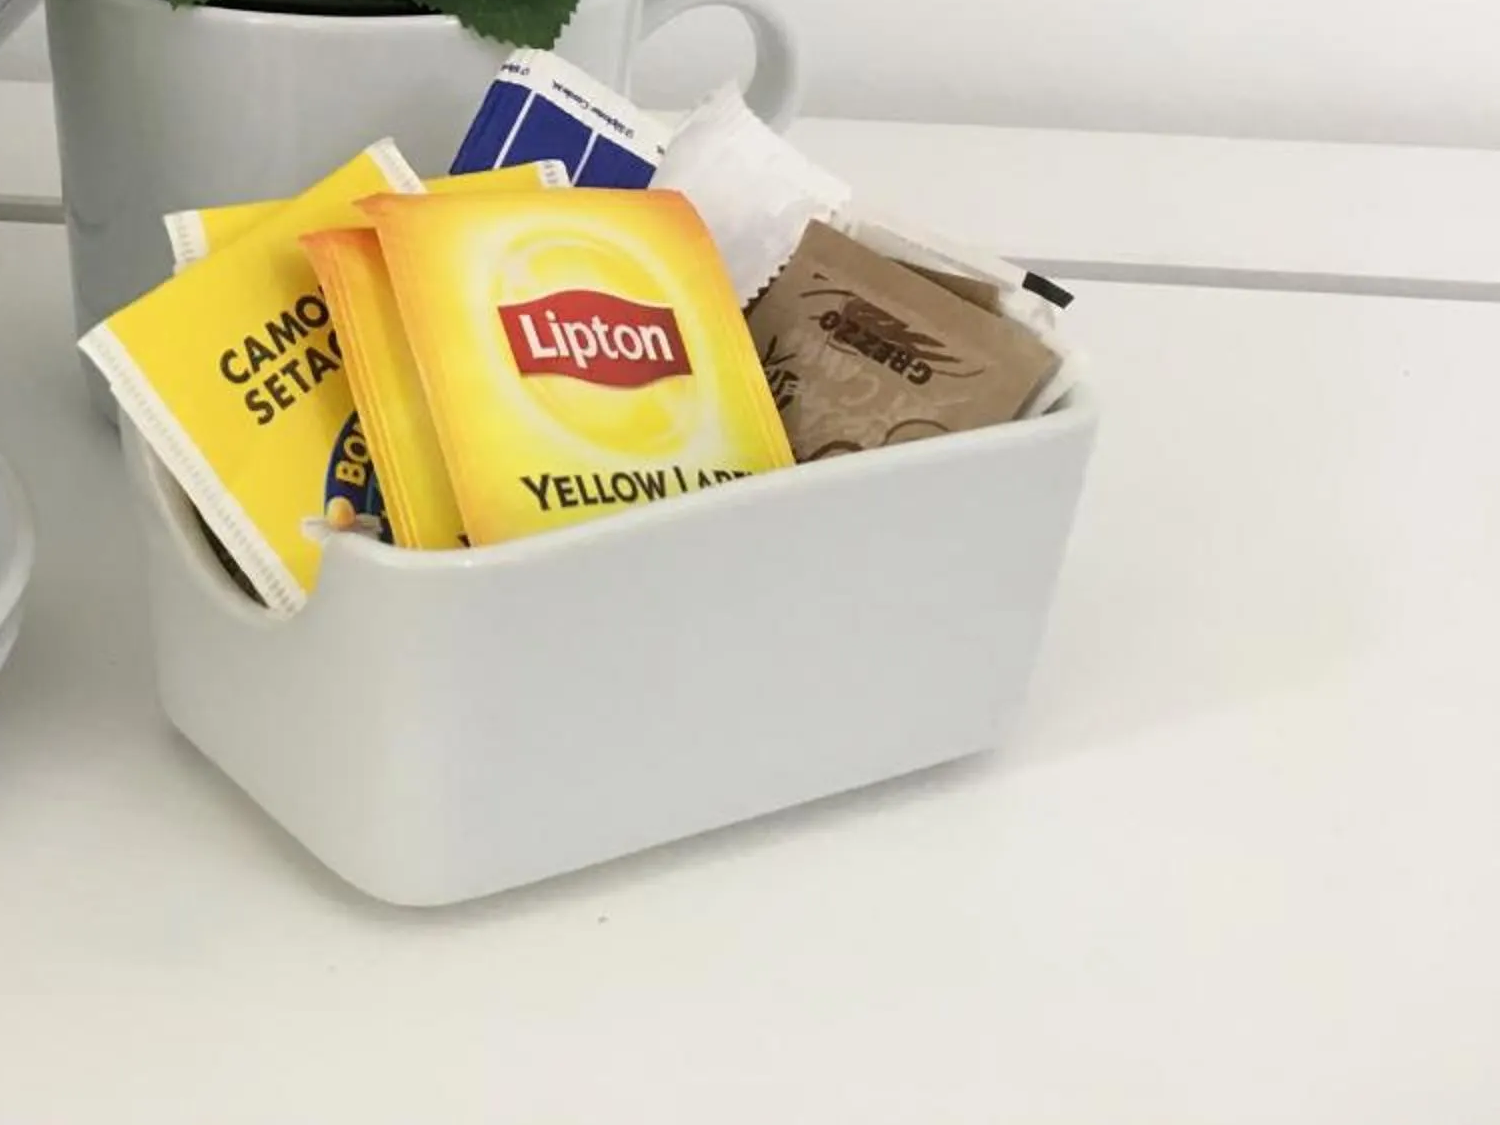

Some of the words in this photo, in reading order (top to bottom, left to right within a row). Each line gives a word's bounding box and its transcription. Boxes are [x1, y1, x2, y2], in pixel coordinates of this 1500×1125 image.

[219, 287, 330, 384] CAMO
[517, 309, 675, 369] Lipton
[335, 422, 370, 487] BO
[518, 470, 667, 512] YELLOW
